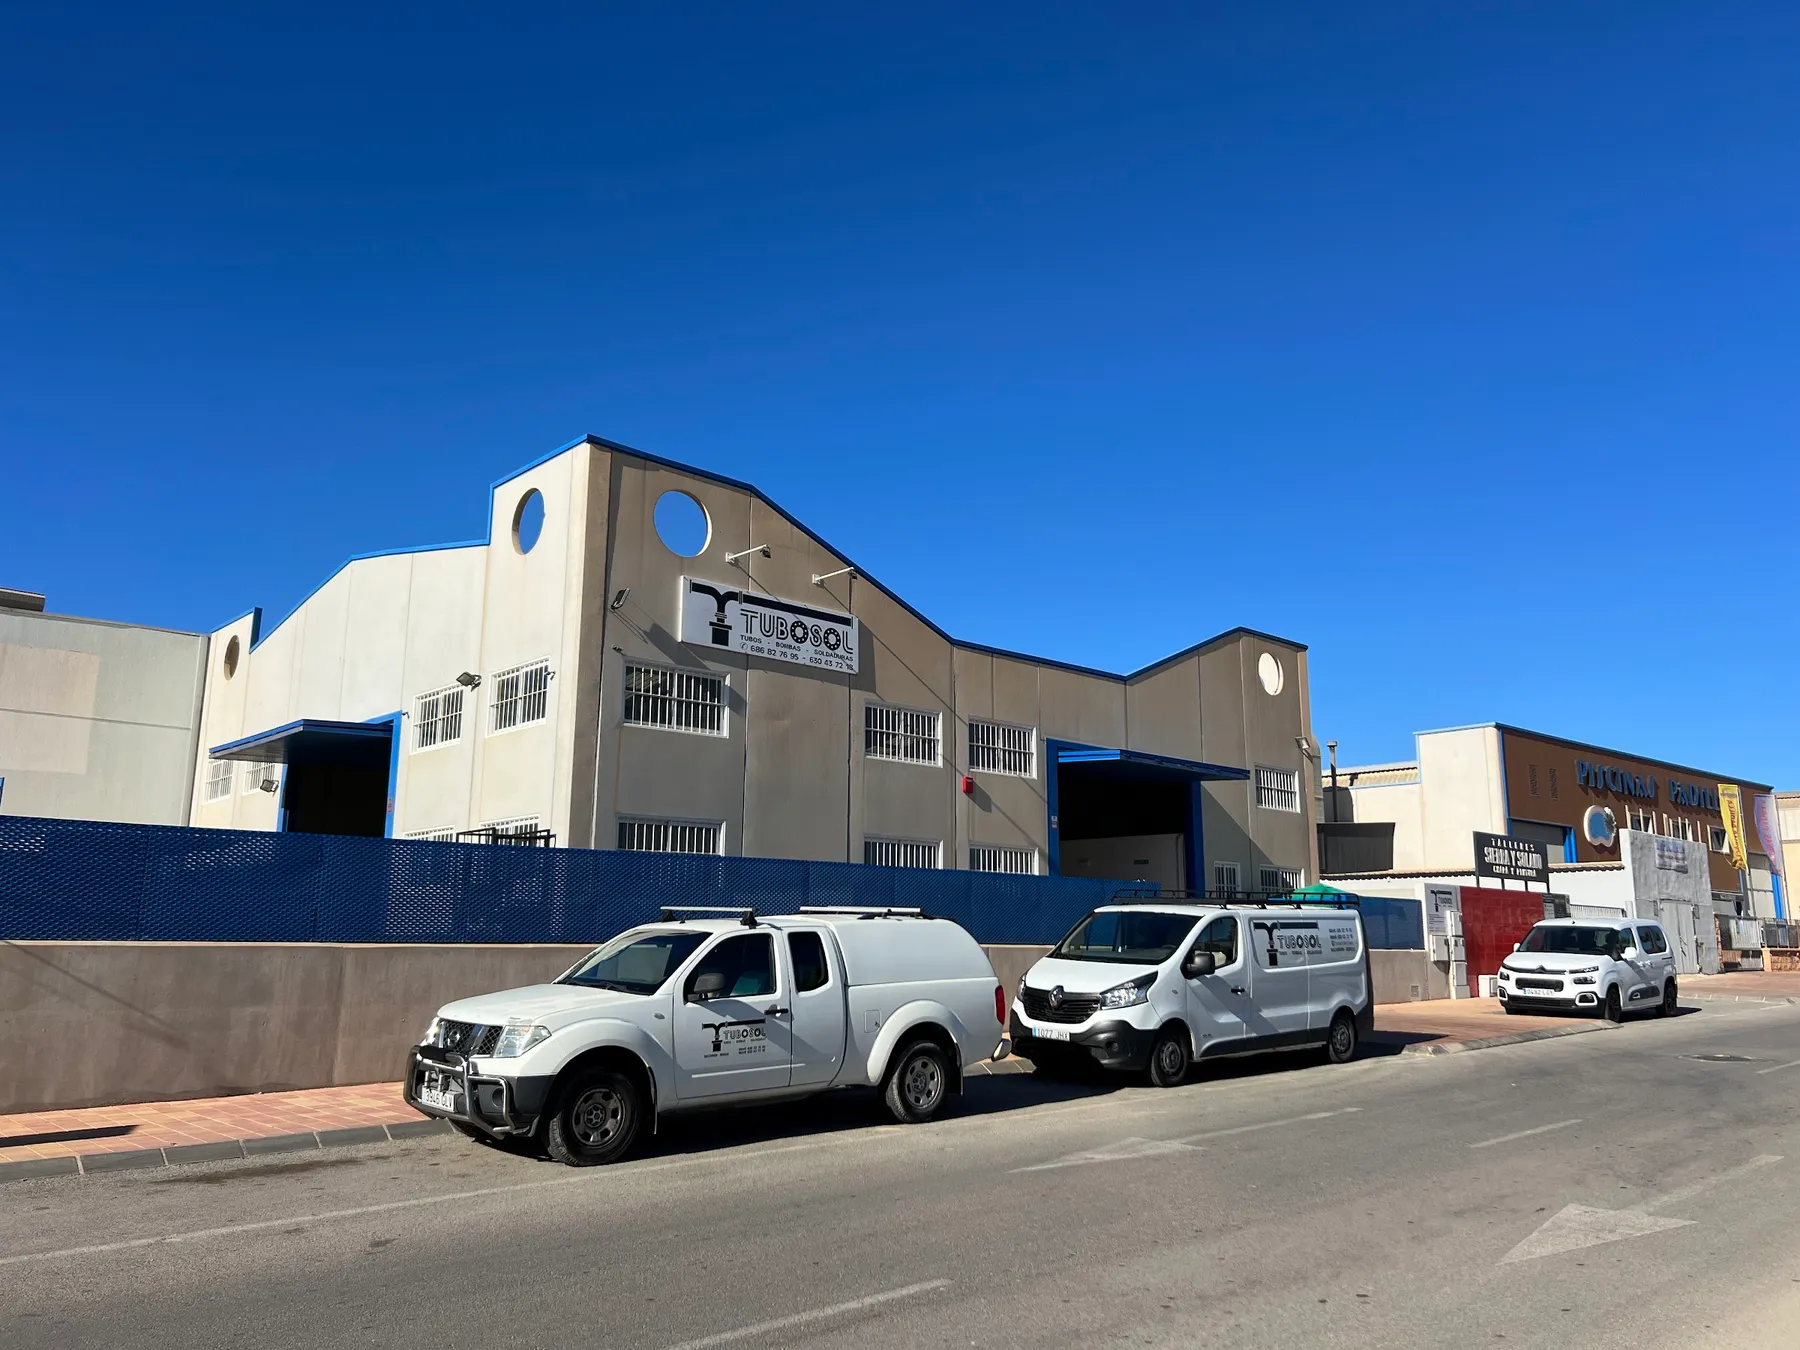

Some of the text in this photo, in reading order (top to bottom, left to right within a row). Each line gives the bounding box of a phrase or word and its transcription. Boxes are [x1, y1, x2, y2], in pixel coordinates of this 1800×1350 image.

[740, 608, 853, 654] TUBOSOL
[740, 634, 762, 644] TUBOS
[775, 641, 801, 652] BOMBAS
[814, 649, 853, 662] SOLDADURAS
[750, 645, 765, 654] 686
[767, 648, 776, 656] 82
[779, 651, 788, 659] 76
[809, 656, 822, 665] 630
[824, 659, 833, 667] 43
[835, 661, 843, 669] 72
[1576, 760, 1656, 799] PISCINAS
[1668, 777, 1720, 811] PADILL
[1491, 838, 1535, 851] TALLERES
[1510, 850, 1516, 866] Y
[1277, 934, 1322, 949] TUBOSOL
[723, 1027, 766, 1040] TUBOSOL
